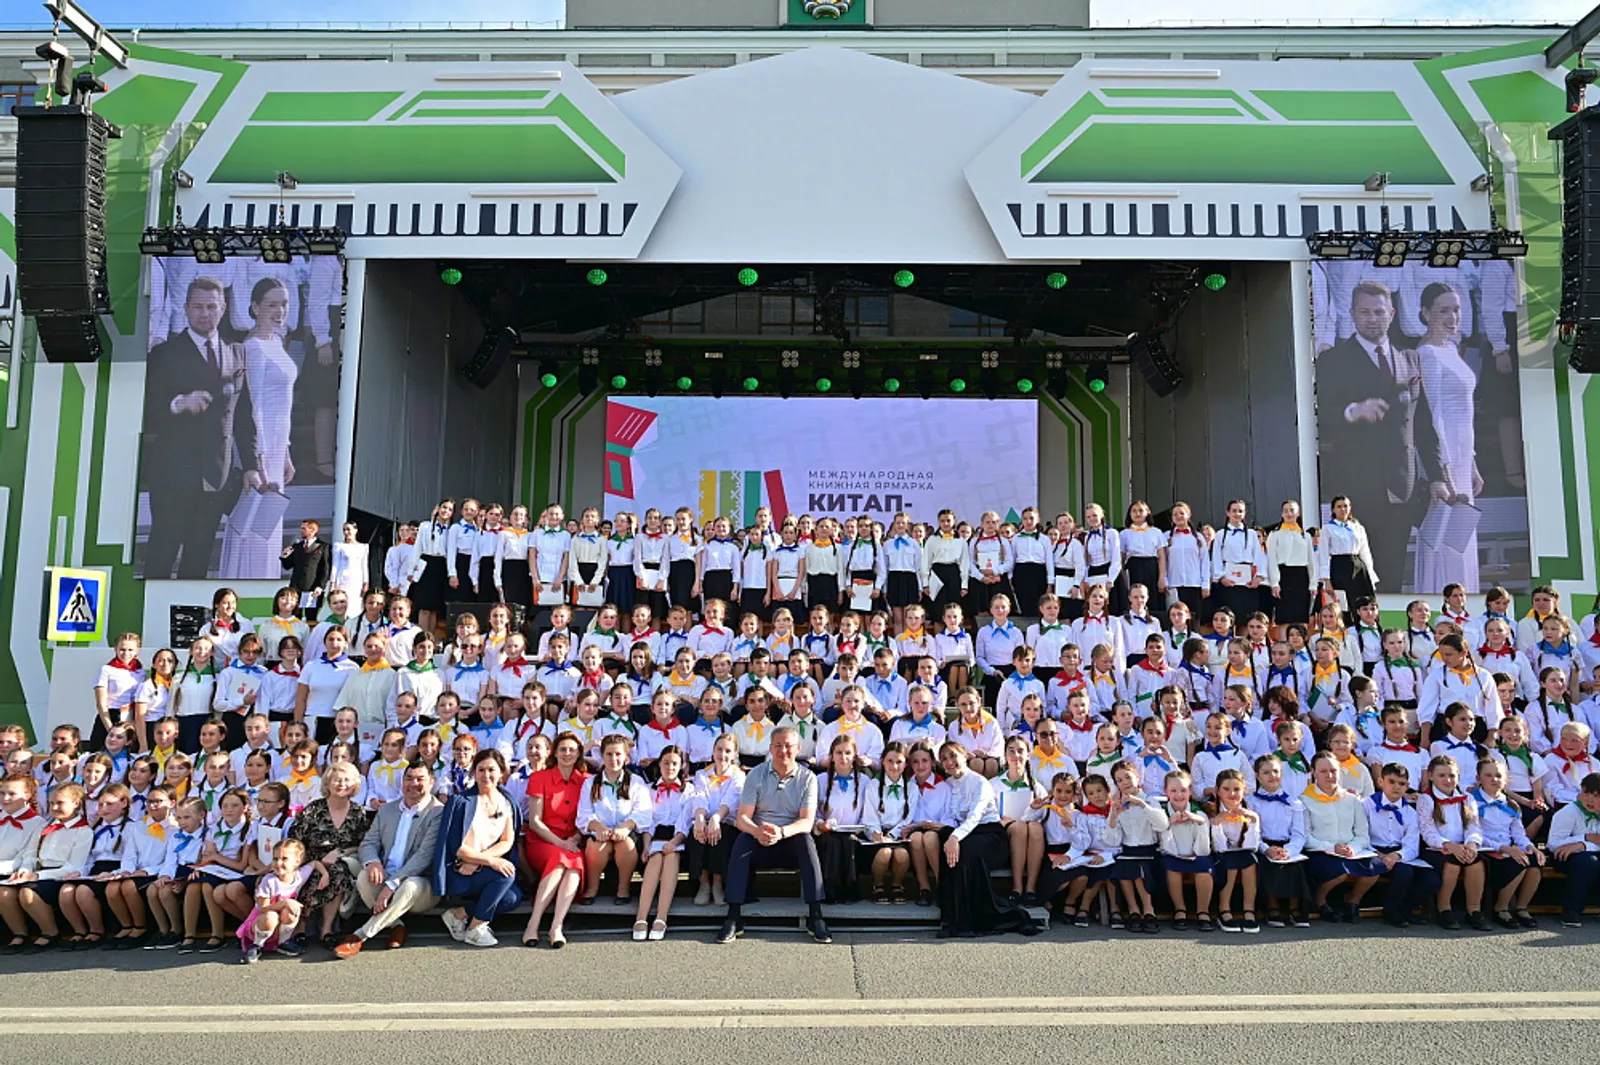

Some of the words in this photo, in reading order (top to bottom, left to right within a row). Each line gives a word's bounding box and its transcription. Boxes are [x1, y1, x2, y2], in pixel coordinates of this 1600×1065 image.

[808, 470, 934, 480] МЕЖДУНАРОДНАЯ
[808, 481, 870, 490] КНИЖНАЯ
[874, 481, 934, 490] ЯРМАРКА
[808, 493, 913, 512] КИТАП-
